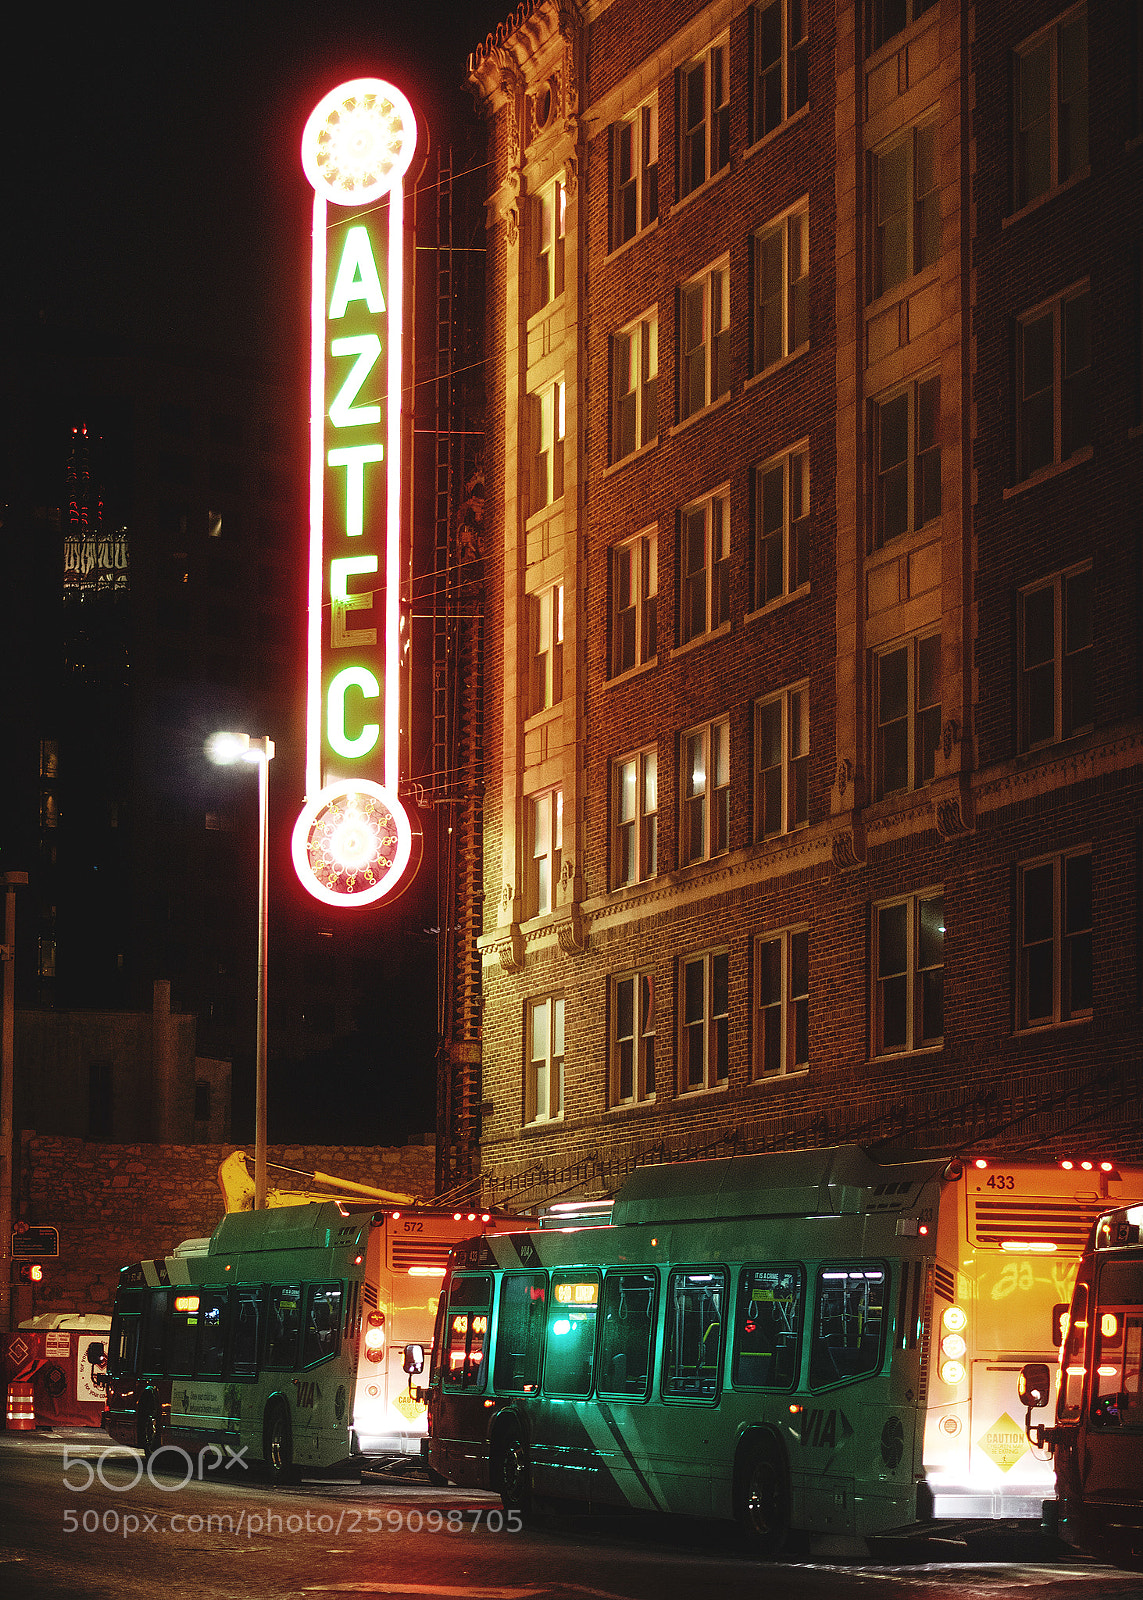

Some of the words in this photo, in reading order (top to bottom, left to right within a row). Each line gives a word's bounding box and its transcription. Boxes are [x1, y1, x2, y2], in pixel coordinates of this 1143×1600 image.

[326, 226, 386, 759] AZTEC
[986, 1175, 1015, 1190] 433
[404, 1222, 423, 1232] 572
[31, 1265, 42, 1280] 6
[800, 1408, 837, 1448] VIA
[987, 1434, 1024, 1443] CAUTION
